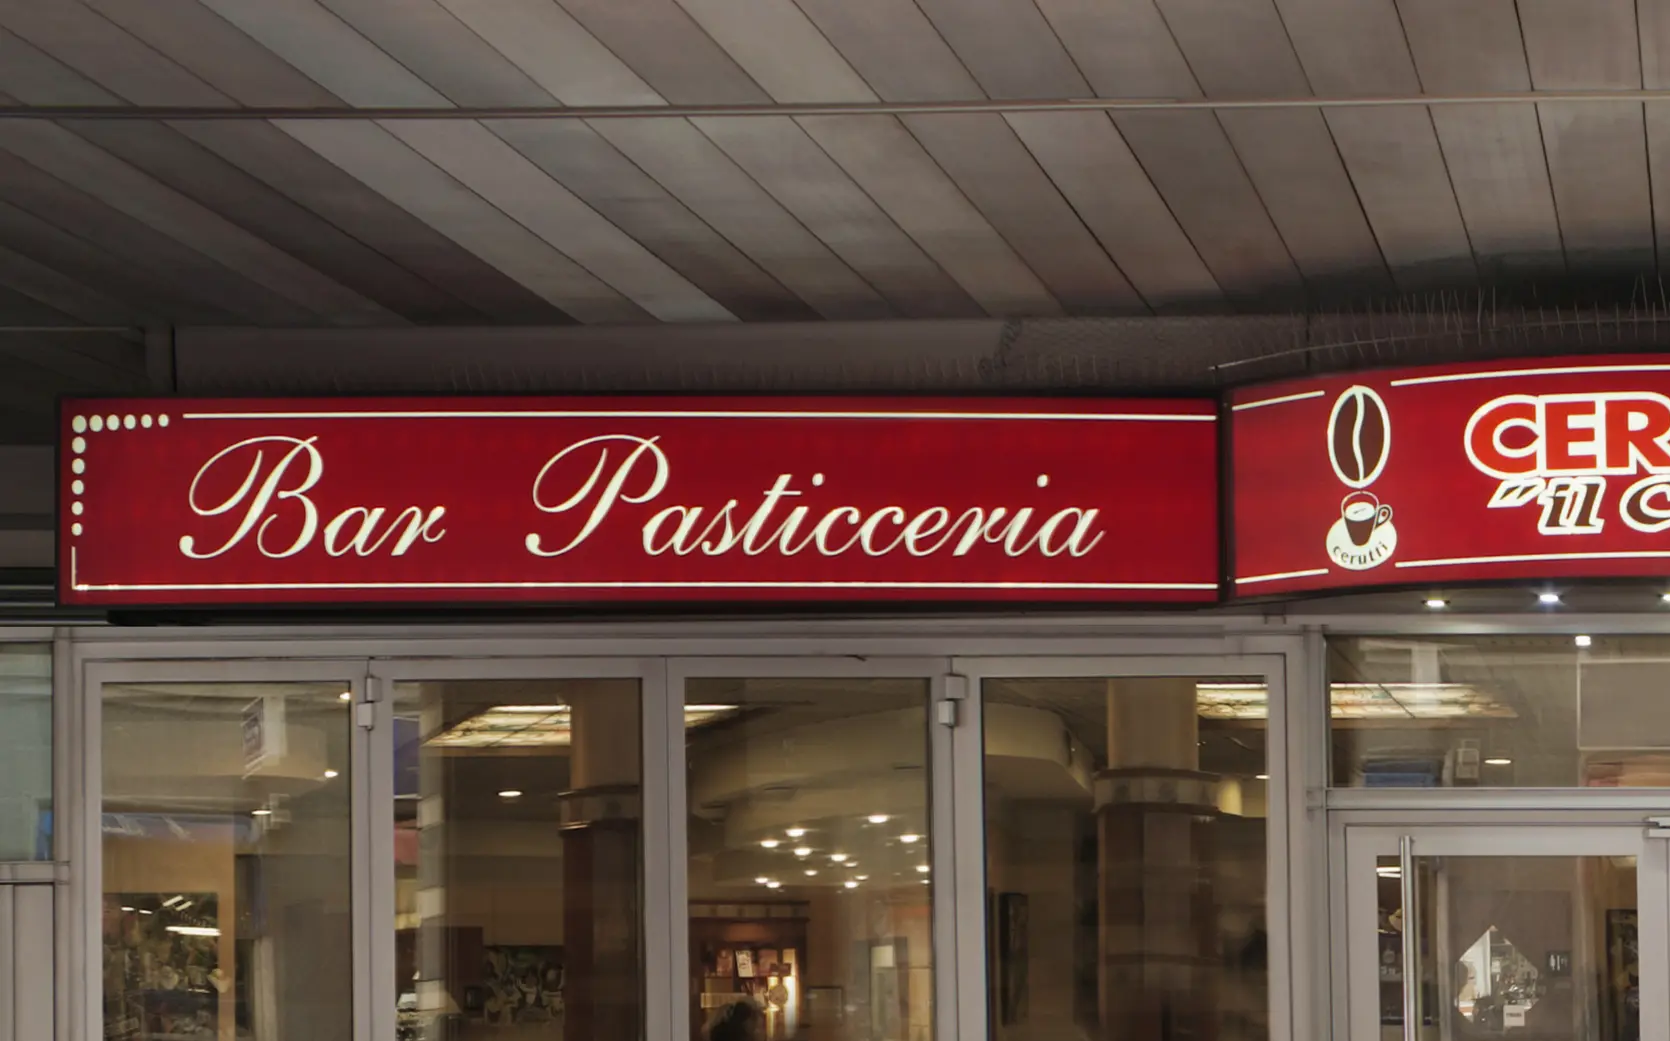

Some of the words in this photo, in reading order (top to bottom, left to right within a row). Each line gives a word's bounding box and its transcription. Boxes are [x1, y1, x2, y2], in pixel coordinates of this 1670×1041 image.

[179, 435, 446, 559] Bar
[525, 434, 1105, 557] Pasticceria
[1332, 540, 1388, 565] cerutti
